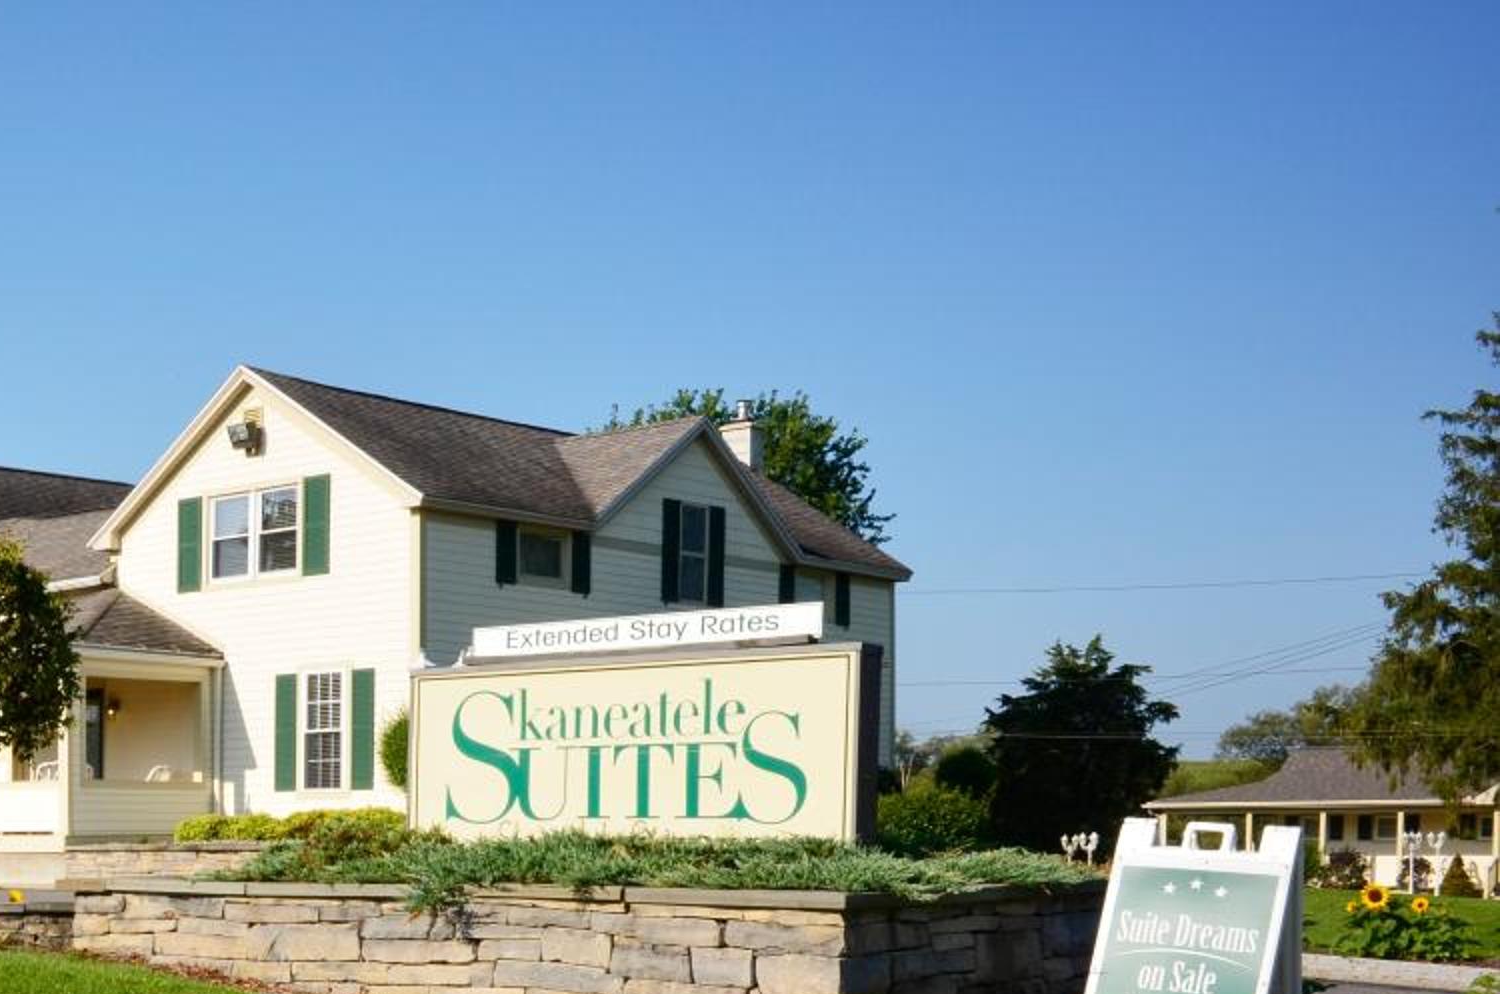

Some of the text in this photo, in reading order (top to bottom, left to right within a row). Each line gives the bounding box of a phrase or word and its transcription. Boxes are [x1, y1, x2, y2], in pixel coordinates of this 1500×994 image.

[506, 613, 780, 649] Extended Stay Rates
[445, 690, 808, 824] SUITES
[1116, 910, 1259, 953] Suite Dreams
[1137, 964, 1165, 991] on
